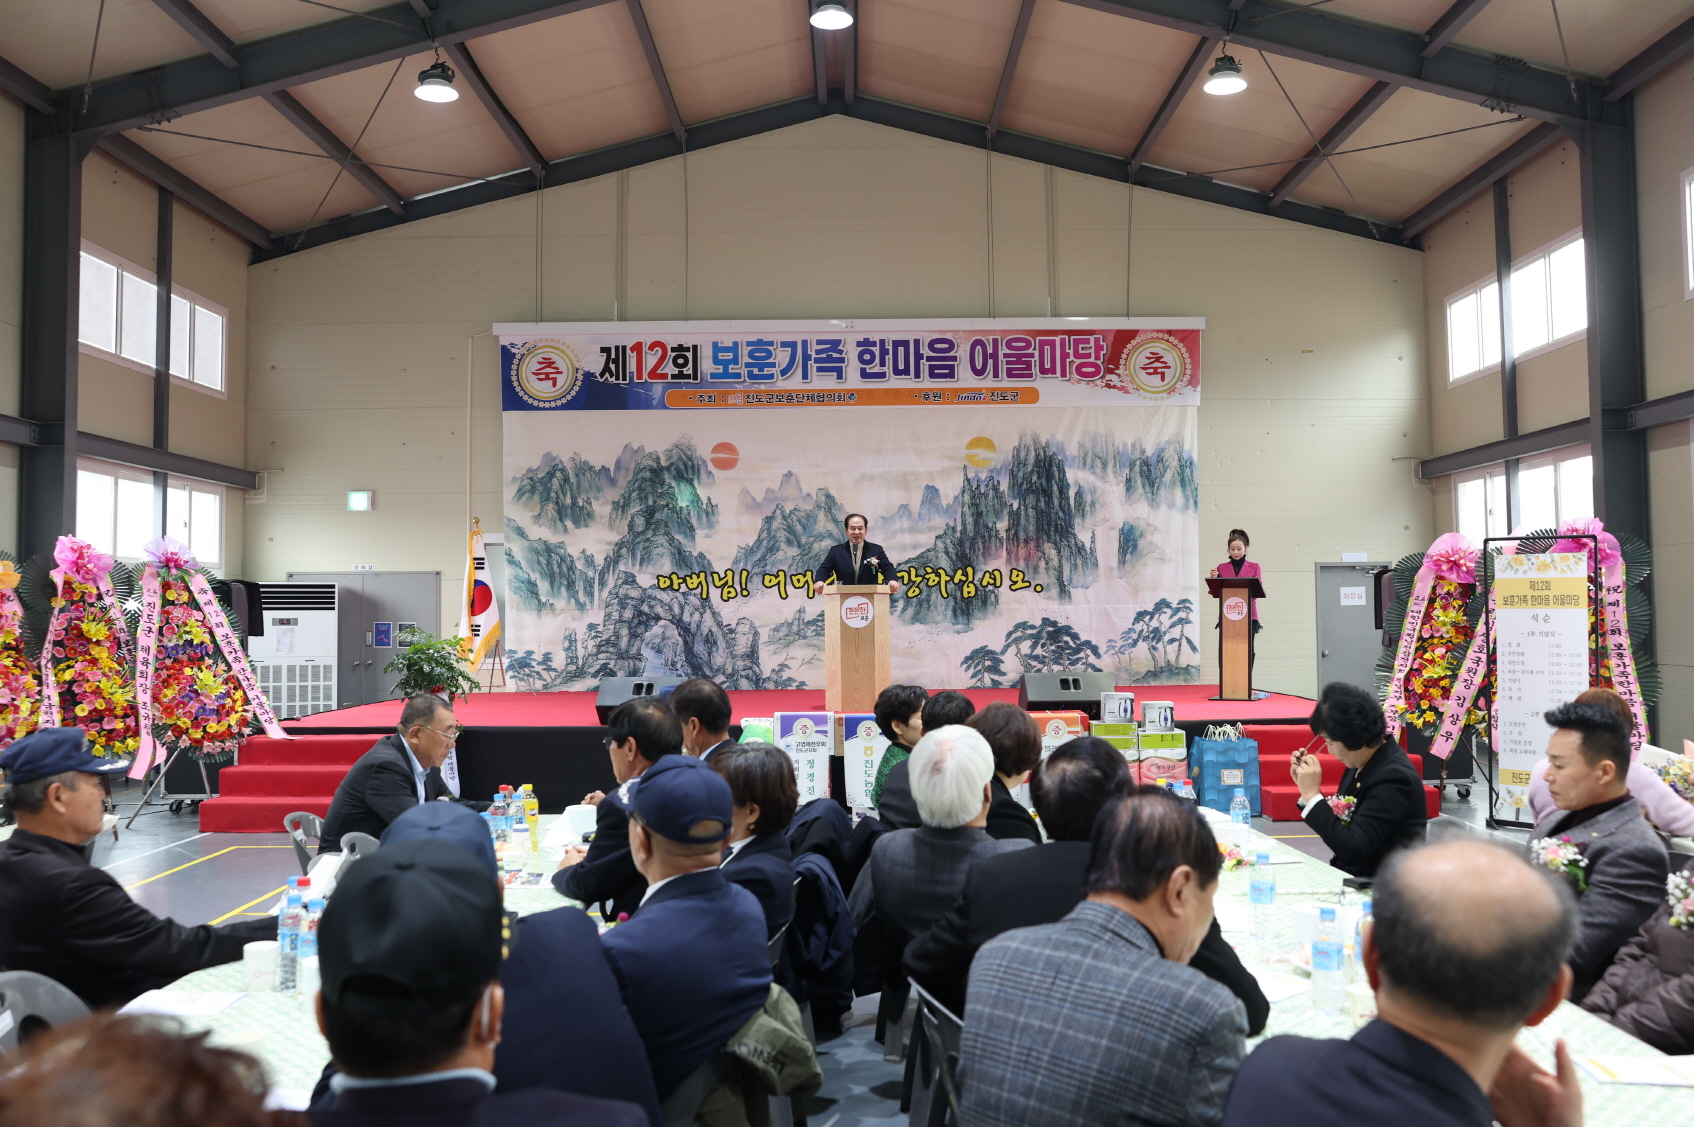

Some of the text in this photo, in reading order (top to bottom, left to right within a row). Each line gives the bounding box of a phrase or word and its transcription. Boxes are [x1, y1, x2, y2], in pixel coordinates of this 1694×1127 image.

[530, 356, 564, 388] 축
[598, 335, 1107, 384] 제12회 보훈가족 한마음 어울마당
[1138, 351, 1172, 382] 축
[696, 393, 717, 404] 주최
[744, 392, 847, 405] 진도군보훈단체협의회
[921, 391, 943, 403] 후원
[954, 392, 983, 403] Jindo
[989, 390, 1021, 403] 진도군
[657, 566, 1044, 602] 아버님! 어머 강하십시오.
[1343, 592, 1363, 600] 화장실
[1529, 580, 1552, 592] 제12회
[1606, 585, 1623, 595] 祝
[203, 599, 224, 629] 제12회
[1502, 594, 1580, 606] 보훈가족 한마음 어울마당
[142, 601, 156, 638] 진도군
[1606, 599, 1623, 637] 제12회
[220, 632, 243, 665] 보훈가족
[1538, 630, 1556, 638] 기념식
[138, 644, 152, 695] 체육회장
[237, 667, 256, 692] 한마음
[251, 694, 274, 726] 어울마당
[1440, 695, 1466, 742] 김상우
[799, 724, 810, 735] 증
[863, 726, 874, 737] 증
[806, 759, 816, 796] 정경진
[863, 760, 874, 798] 진도농협
[1512, 772, 1530, 785] 진도군
